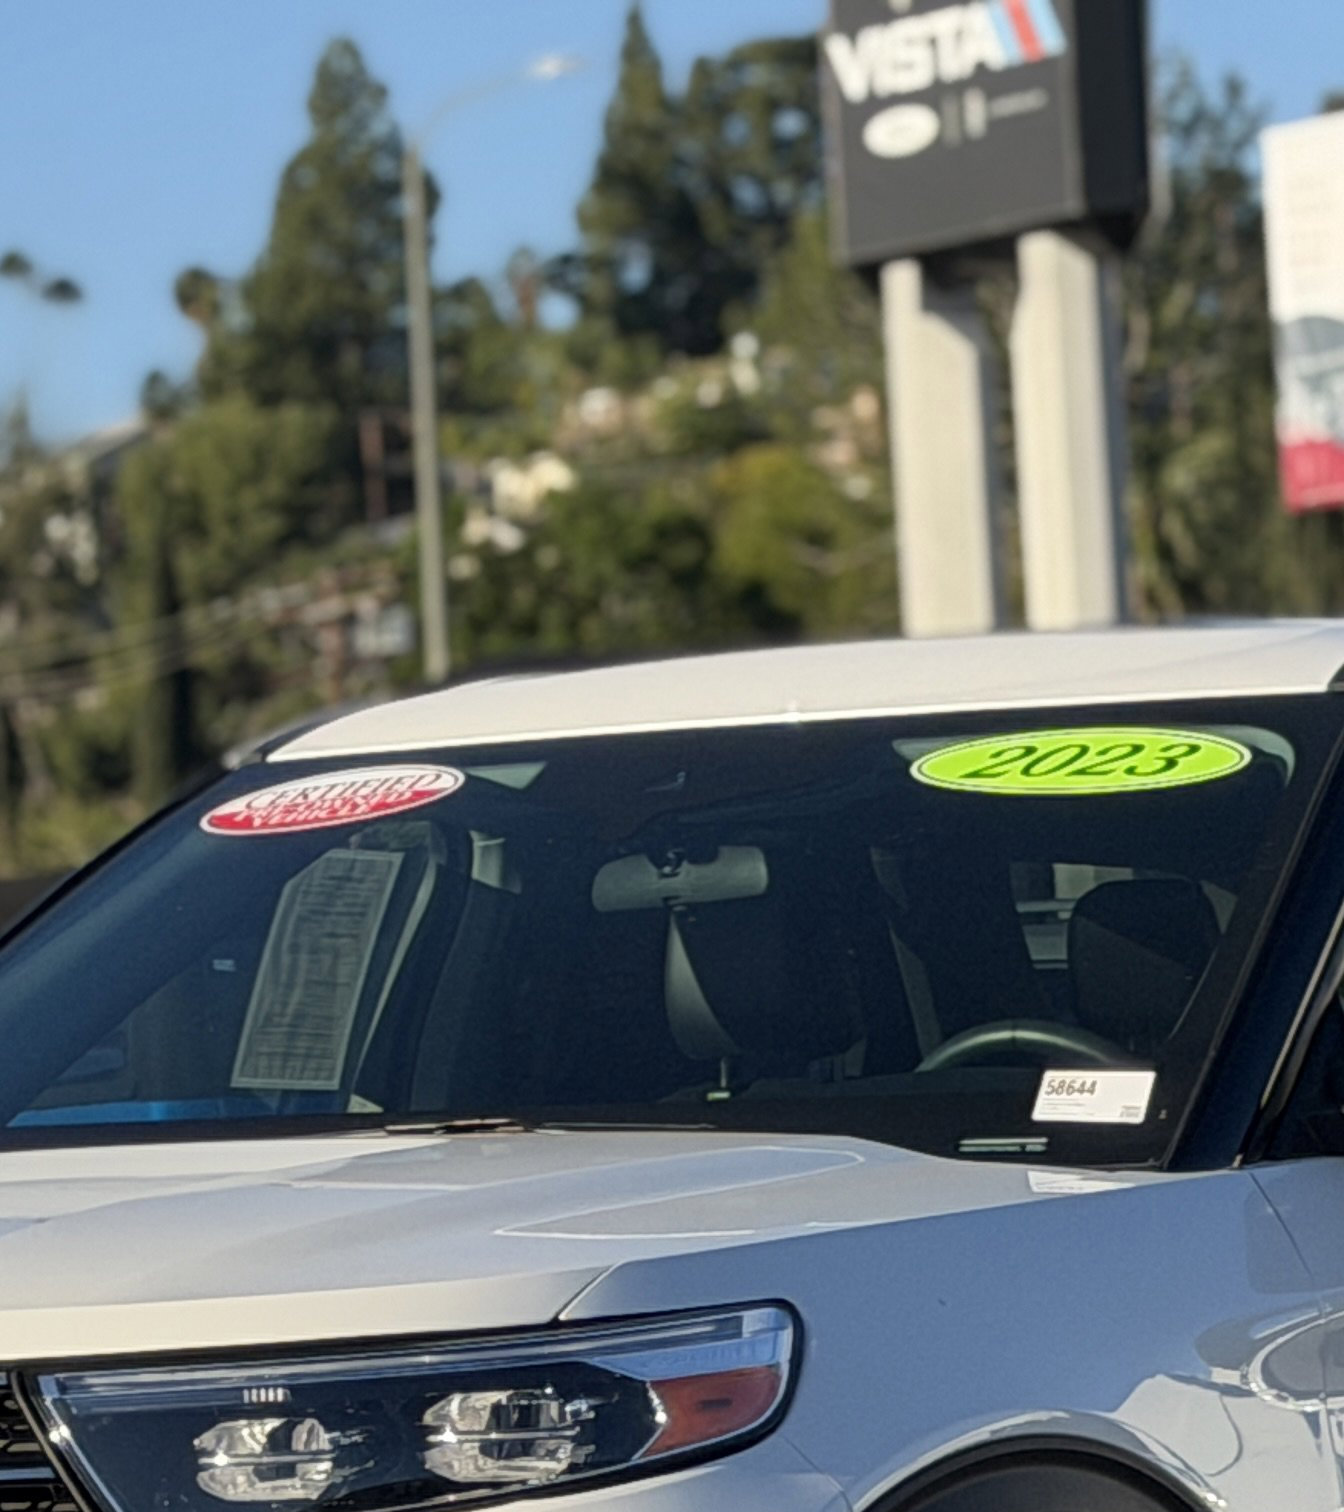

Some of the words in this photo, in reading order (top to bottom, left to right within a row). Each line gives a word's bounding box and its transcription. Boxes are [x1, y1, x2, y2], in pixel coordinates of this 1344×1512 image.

[824, 0, 1008, 104] VISTA
[957, 743, 1203, 779] 2023
[245, 773, 442, 811] CERTIFIED
[1044, 1079, 1098, 1096] 58644
